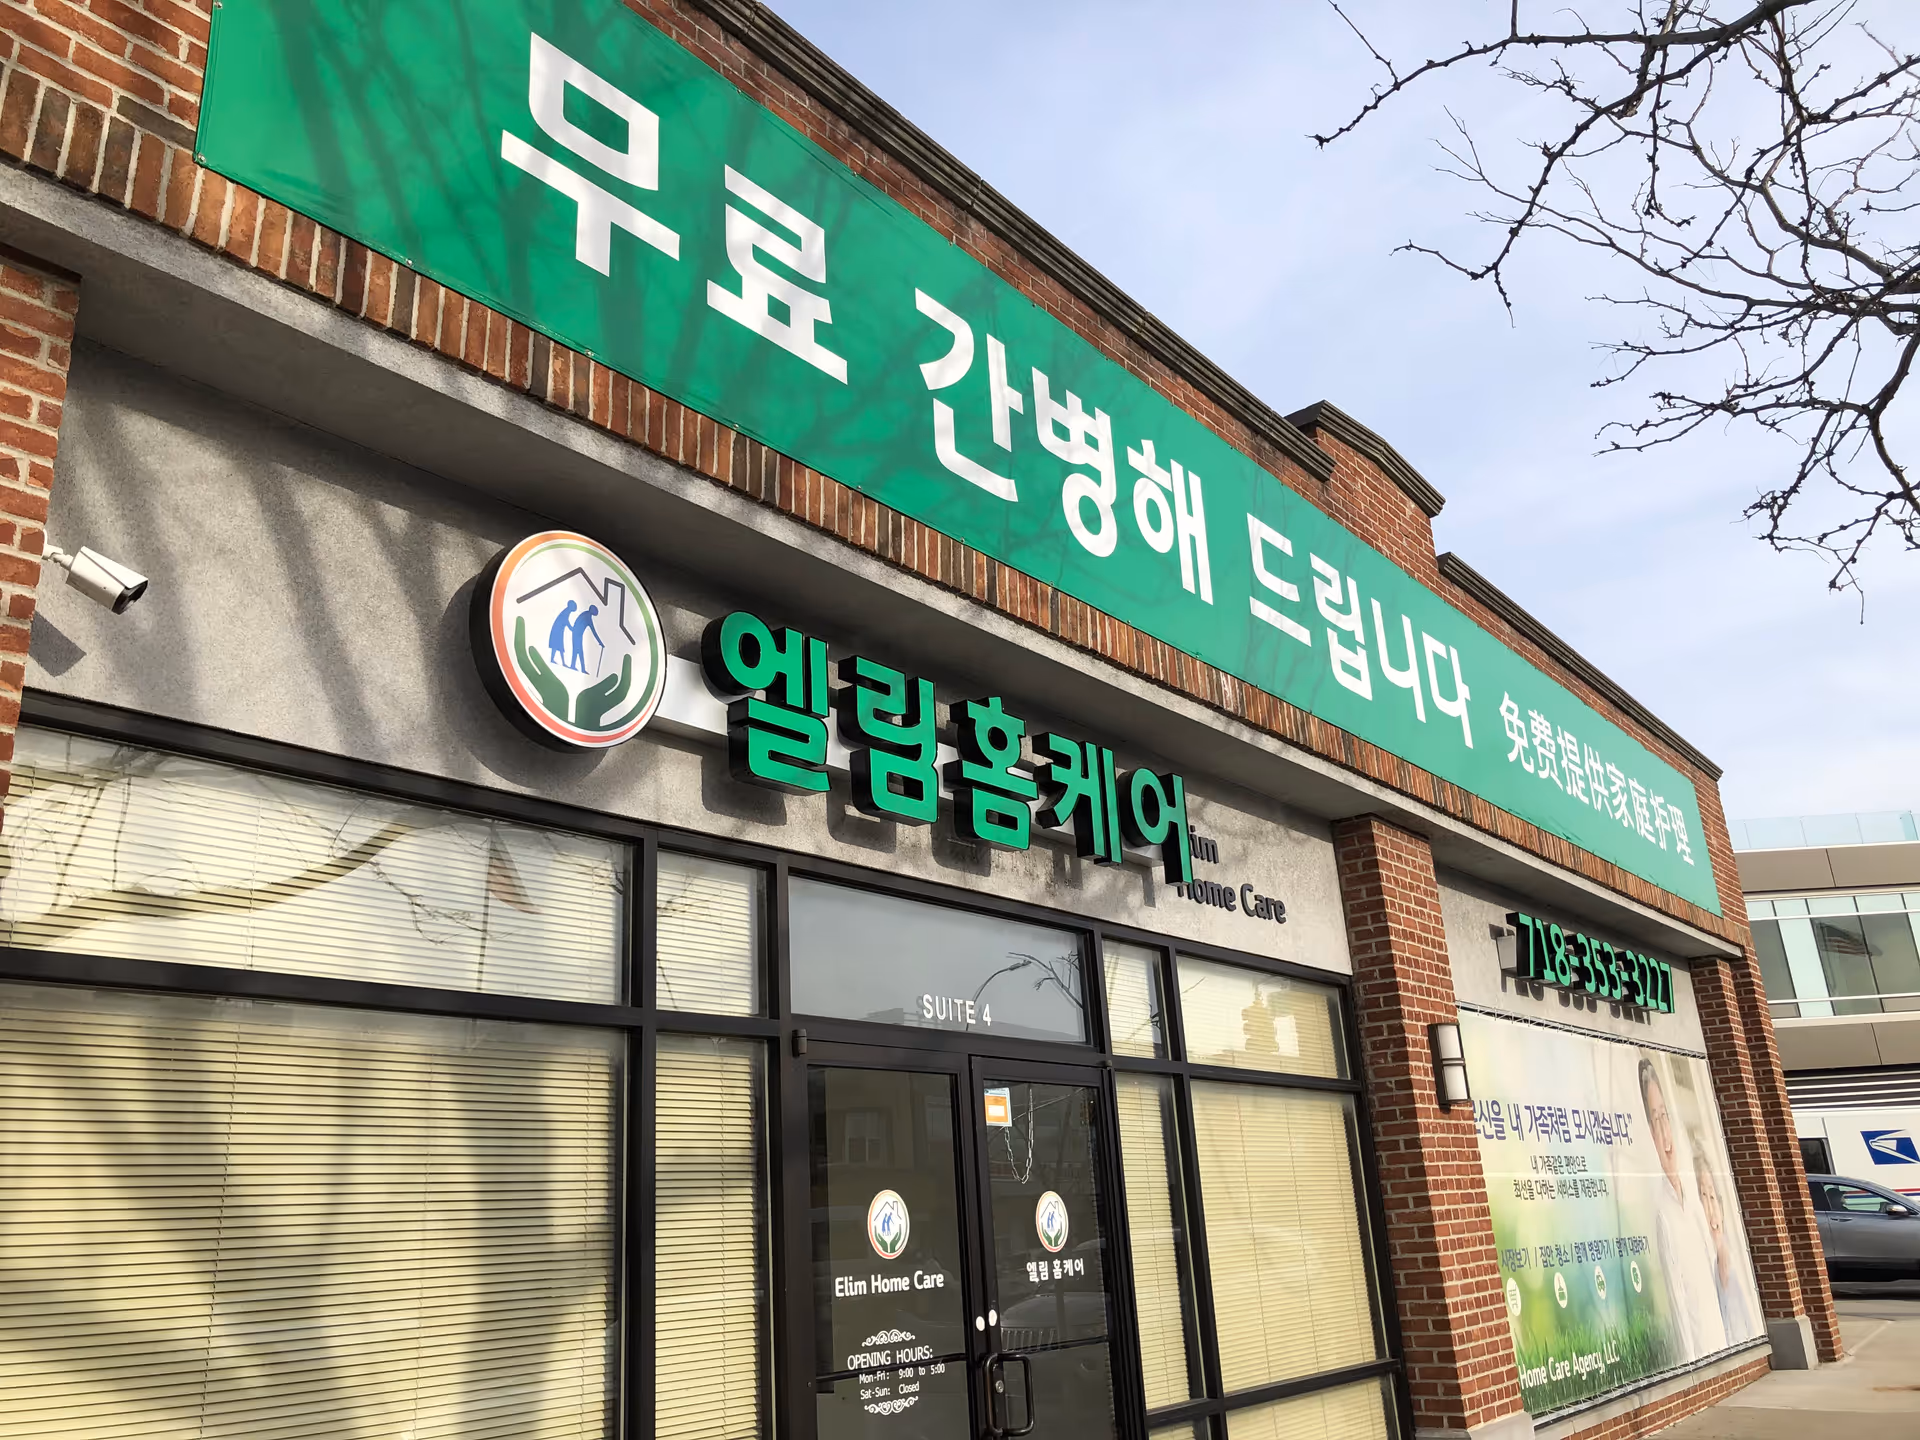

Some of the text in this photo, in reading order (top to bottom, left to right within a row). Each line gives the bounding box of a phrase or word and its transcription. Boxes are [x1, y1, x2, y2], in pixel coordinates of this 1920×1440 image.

[501, 32, 1474, 750] 무료 간병해 드립니다
[704, 610, 1193, 885] 엘림홈케어
[1499, 691, 1695, 866] 免费提供家庭护理
[1240, 883, 1286, 924] Care
[1506, 911, 1675, 1014] 718-353-3227
[922, 993, 992, 1026] SUITE 4
[1507, 1103, 1524, 1141] 내
[1524, 1105, 1572, 1143] 가족처럼
[1530, 1155, 1539, 1174] 내
[1539, 1155, 1564, 1175] 가족같은
[1513, 1178, 1609, 1200] 최선을 다하는 서비스를 제공합니다.
[1539, 1245, 1555, 1268] 집안
[1555, 1243, 1570, 1266] 청소
[1574, 1241, 1588, 1263] 함께
[1615, 1237, 1629, 1257] 함께
[835, 1271, 944, 1297] Elim Home Care
[1026, 1258, 1085, 1282] 엘림 홈케어
[847, 1345, 933, 1370] OPENING HOURS:
[898, 1367, 914, 1379] 9:00
[918, 1366, 926, 1376] to
[930, 1363, 945, 1375] 5:00
[1518, 1340, 1620, 1390] Home Care Agency, LLC
[860, 1381, 920, 1400] Sat-Sun: Closed
